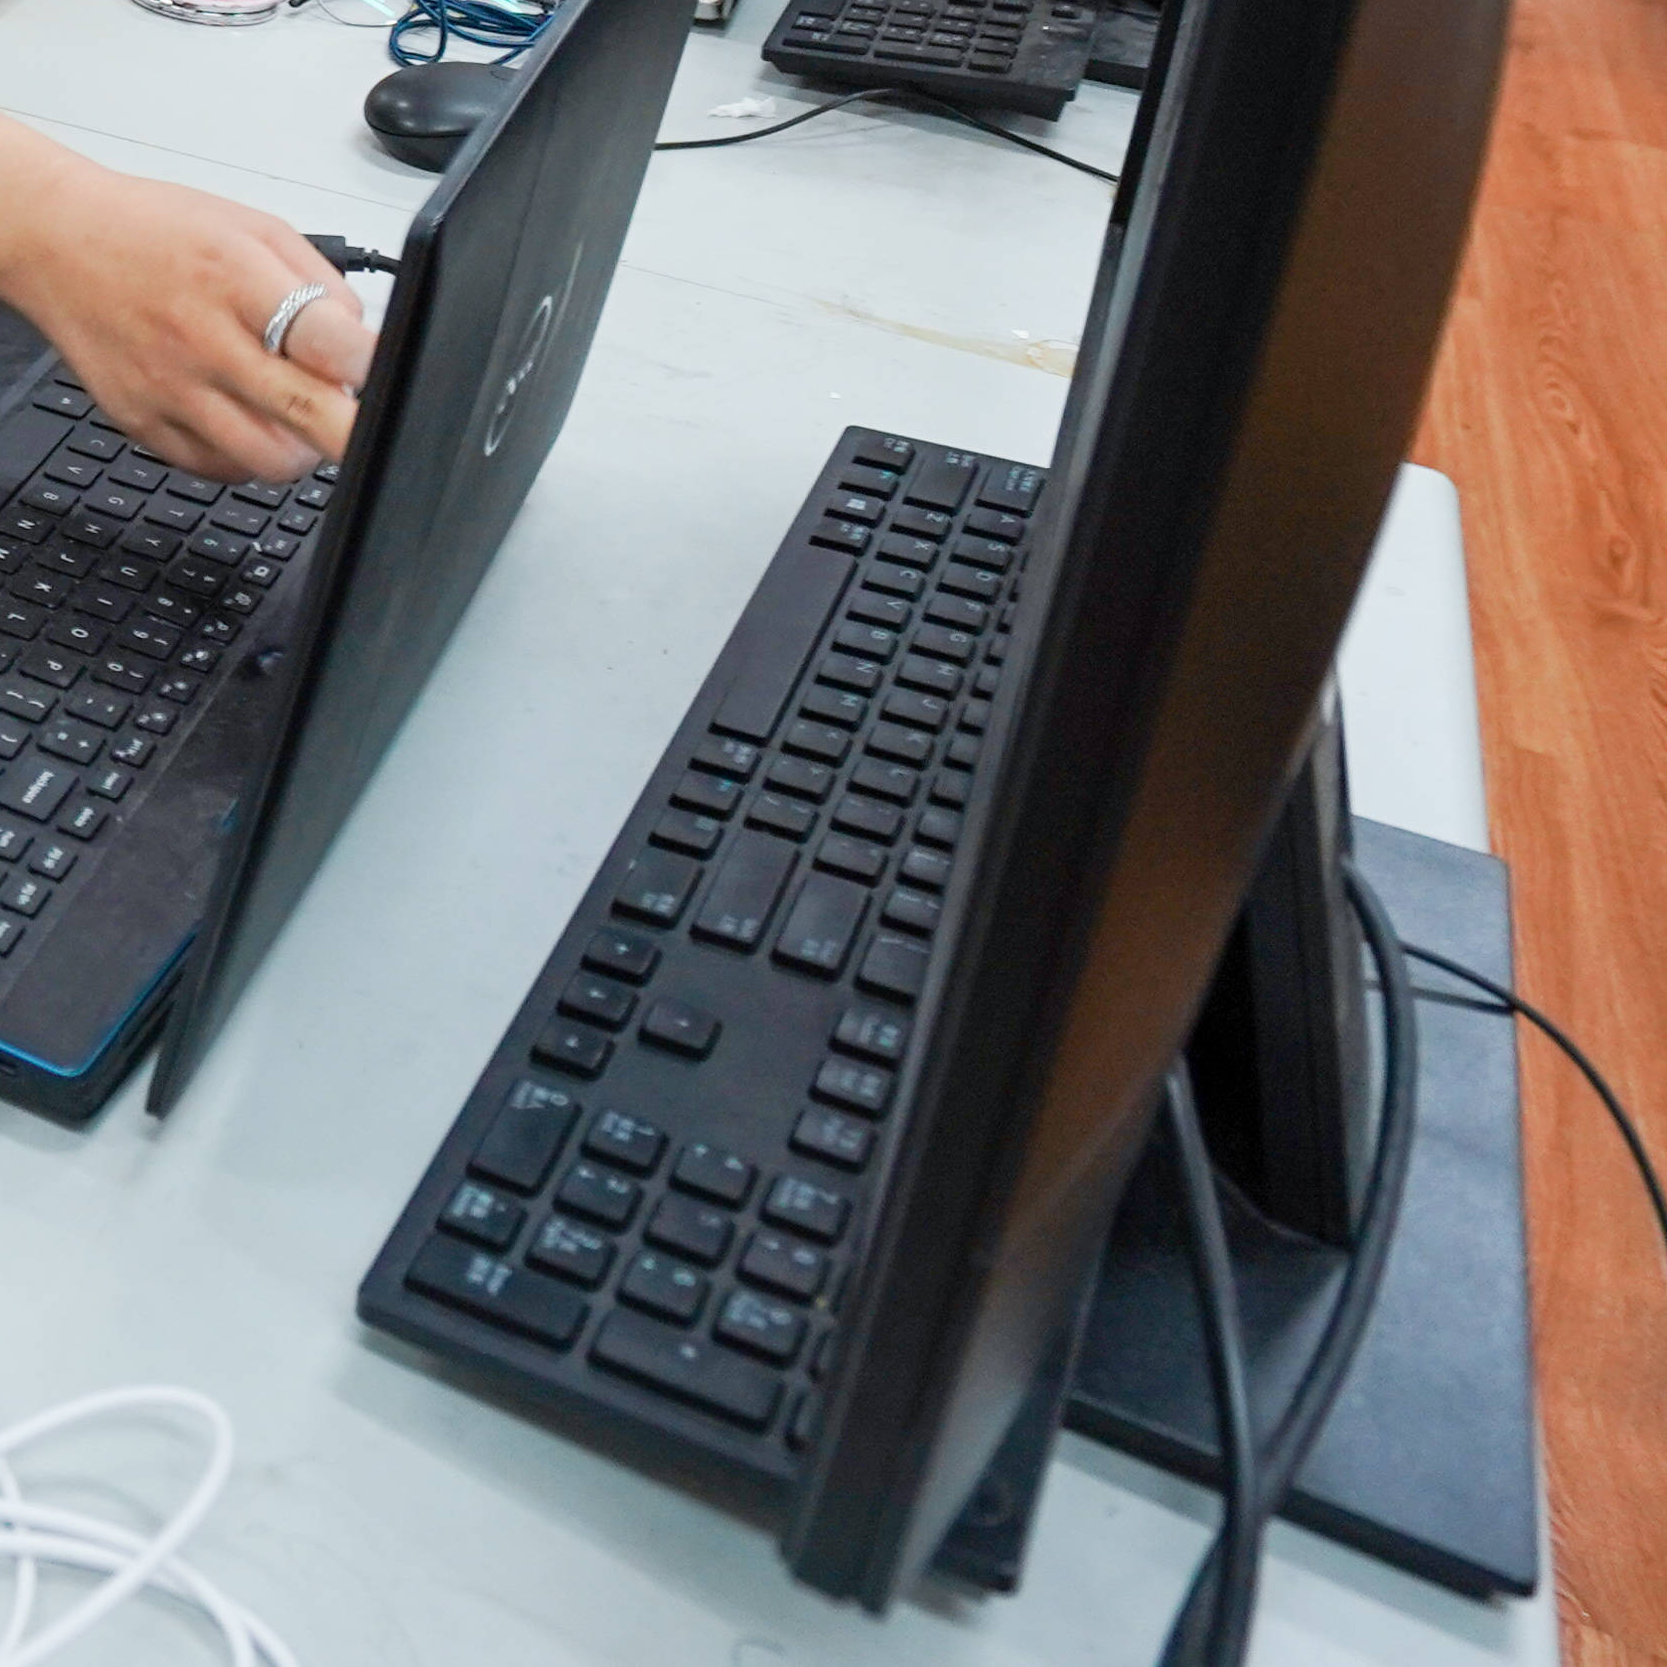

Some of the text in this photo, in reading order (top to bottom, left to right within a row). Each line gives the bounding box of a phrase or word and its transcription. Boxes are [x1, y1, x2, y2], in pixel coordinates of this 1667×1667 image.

[43, 492, 59, 500] B
[109, 497, 124, 505] G
[168, 509, 185, 517] T
[18, 520, 35, 529] N
[86, 524, 101, 533] H
[60, 553, 75, 563] J
[121, 567, 137, 576] U
[35, 583, 51, 591] K
[97, 598, 113, 606] I
[158, 598, 173, 606] 8
[7, 613, 26, 621] L
[72, 628, 88, 637] O
[48, 661, 62, 670] P
[108, 663, 123, 671] 0
